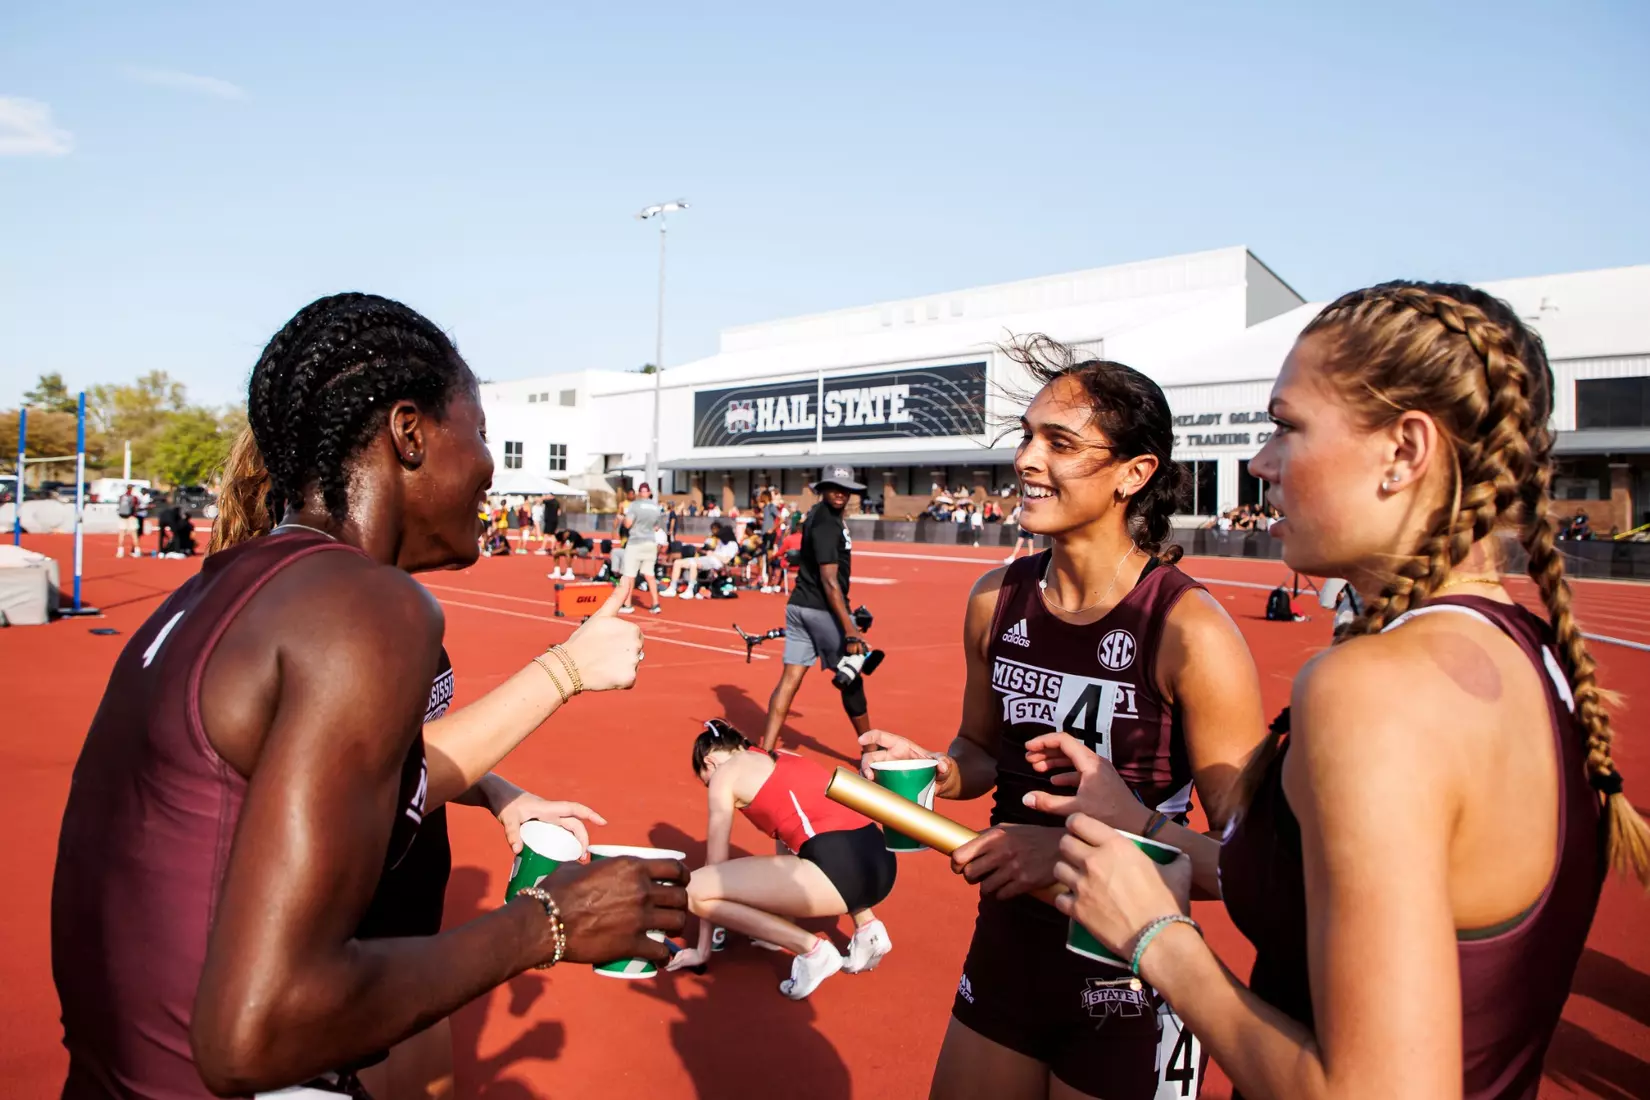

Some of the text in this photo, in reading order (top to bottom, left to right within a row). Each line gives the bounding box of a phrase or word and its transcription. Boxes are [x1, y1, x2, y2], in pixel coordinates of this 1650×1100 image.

[756, 395, 816, 432] HAIL
[824, 385, 910, 427] STATE
[1187, 433, 1251, 446] TRAINING
[1002, 632, 1031, 648] adidas
[1100, 632, 1134, 668] SEC
[992, 661, 1138, 713] MISSISPI
[1016, 702, 1056, 722] STA
[1063, 683, 1103, 755] 4
[1091, 990, 1135, 1003] STATE
[1165, 1025, 1195, 1097] 4
